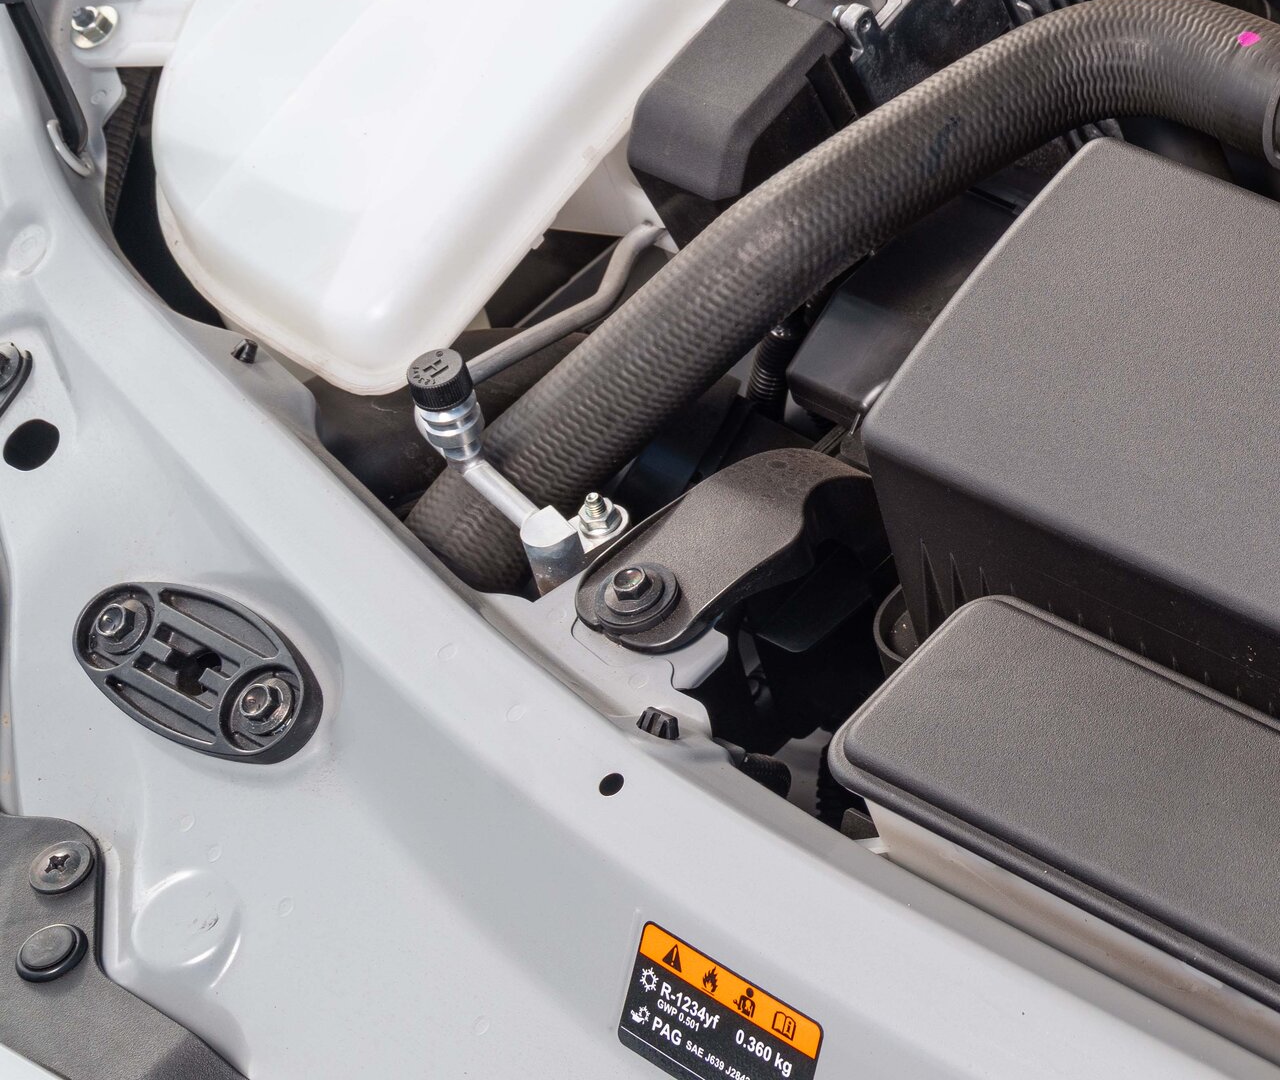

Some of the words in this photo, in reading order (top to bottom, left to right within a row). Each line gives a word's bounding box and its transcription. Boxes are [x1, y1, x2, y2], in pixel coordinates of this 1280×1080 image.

[656, 998, 678, 1017] GWP
[678, 1011, 701, 1032] 0.501
[660, 981, 721, 1030] R-1234yf
[735, 1029, 773, 1062] 0.360
[774, 1052, 794, 1078] kg
[652, 1016, 683, 1047] PAG
[685, 1040, 704, 1058] SAE
[704, 1052, 725, 1071] J639
[725, 1066, 751, 1080] J284
